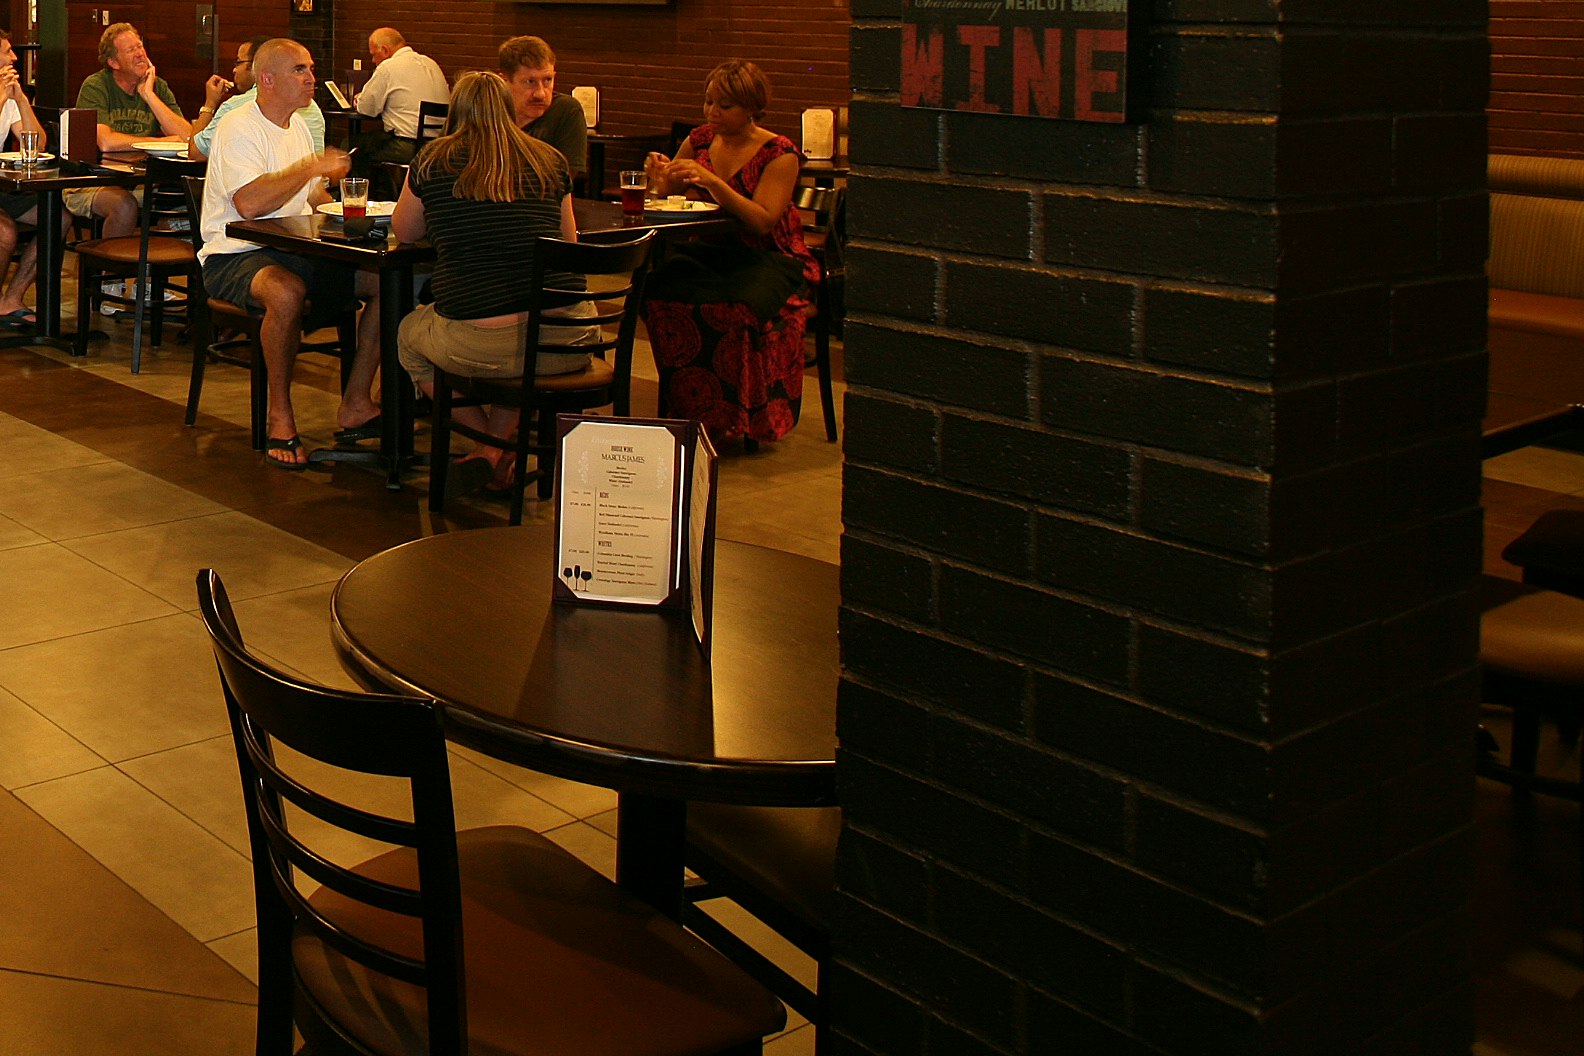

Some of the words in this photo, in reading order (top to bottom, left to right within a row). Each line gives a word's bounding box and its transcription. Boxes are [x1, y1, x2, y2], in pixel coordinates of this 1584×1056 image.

[901, 23, 1126, 124] WINE
[601, 453, 626, 462] MARCUS
[626, 455, 646, 464] JAMES
